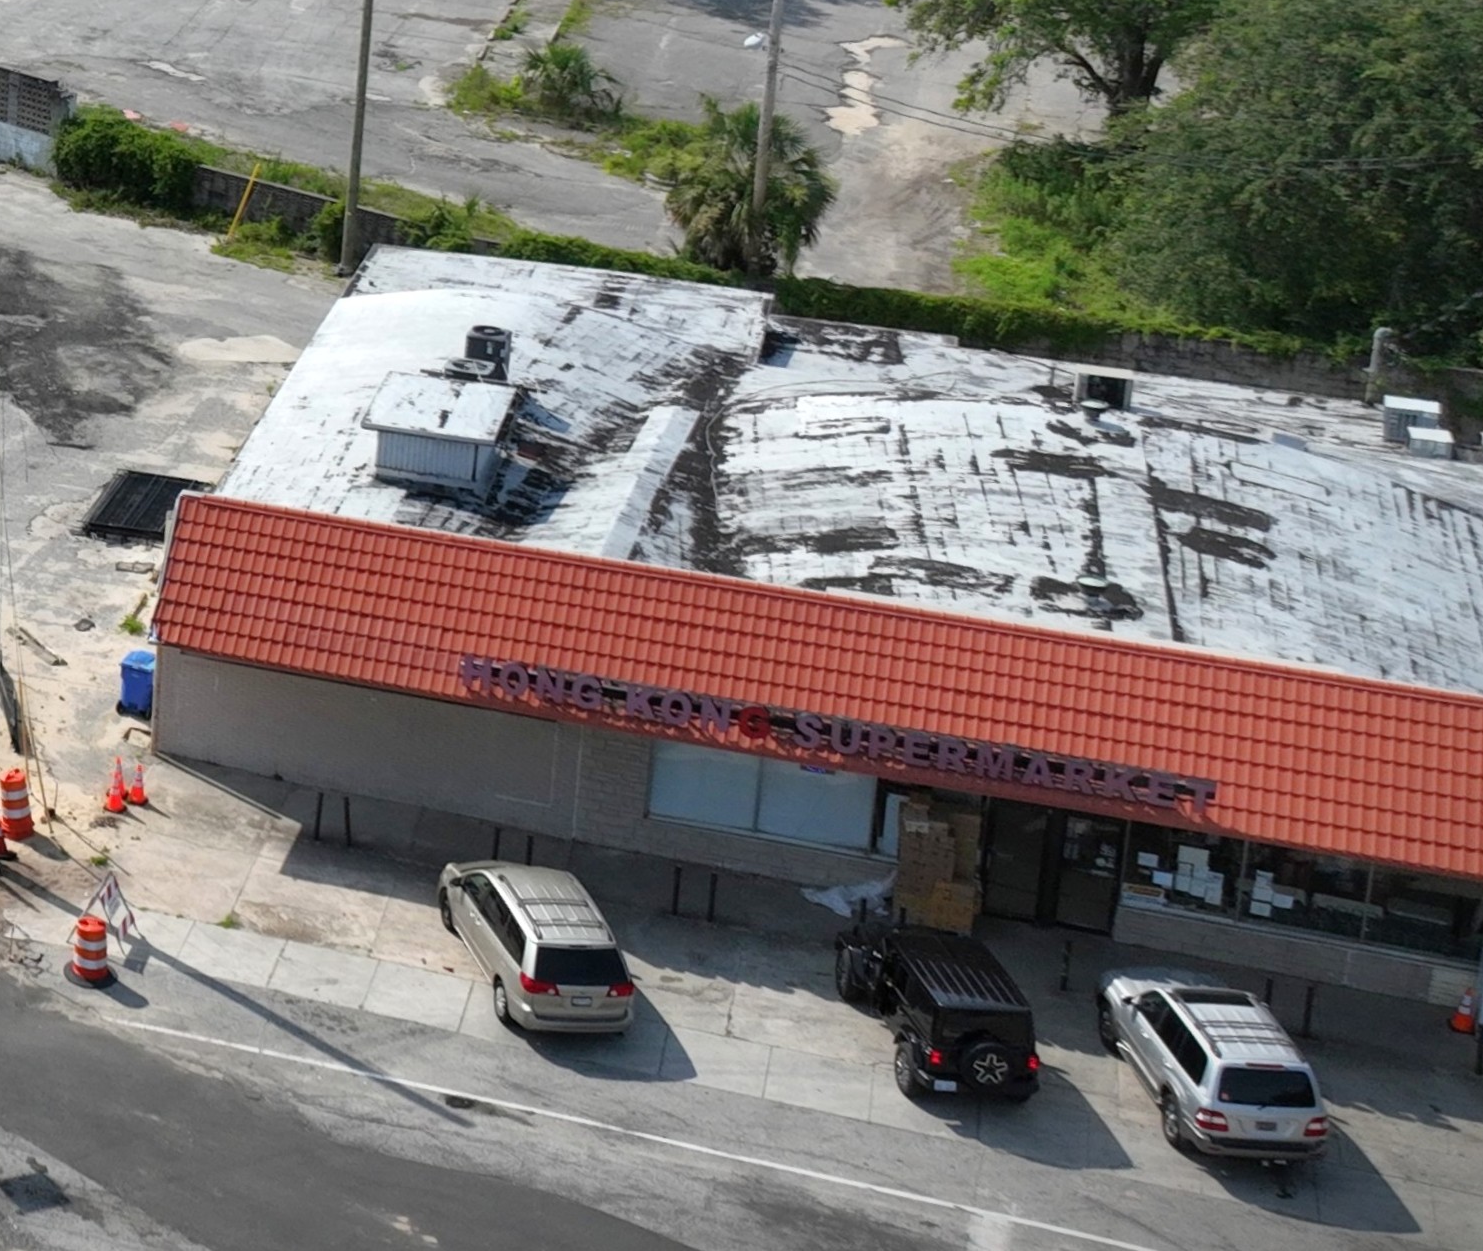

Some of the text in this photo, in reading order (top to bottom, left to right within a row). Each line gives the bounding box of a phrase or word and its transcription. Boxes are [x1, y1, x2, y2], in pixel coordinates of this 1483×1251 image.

[460, 654, 1217, 812] HONG KONG SUPERMARKET
